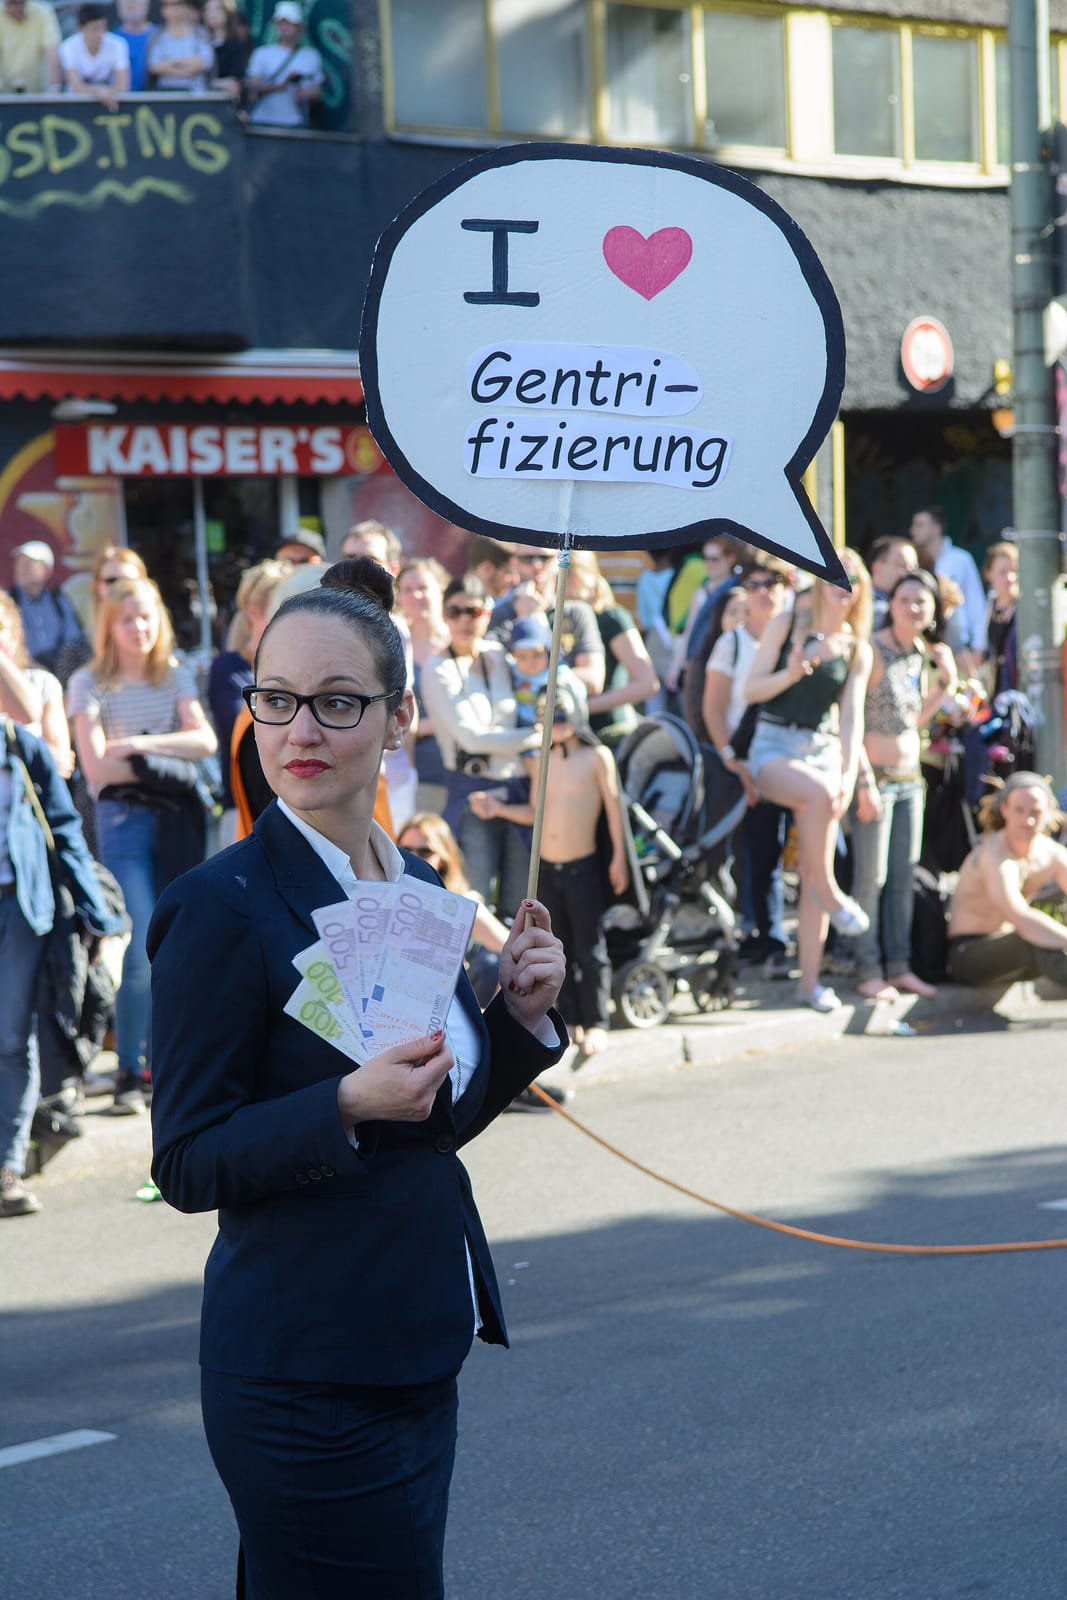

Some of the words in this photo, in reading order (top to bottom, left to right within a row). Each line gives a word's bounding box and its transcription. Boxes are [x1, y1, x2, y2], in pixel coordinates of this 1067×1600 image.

[460, 218, 540, 307] I
[470, 350, 699, 408] Gentri-
[87, 426, 345, 475] KAISER'S
[467, 417, 728, 488] fizierung
[356, 897, 380, 944] 500
[391, 893, 423, 939] 500
[322, 922, 353, 970] 500
[307, 962, 343, 1005] 100
[300, 1001, 339, 1037] 100
